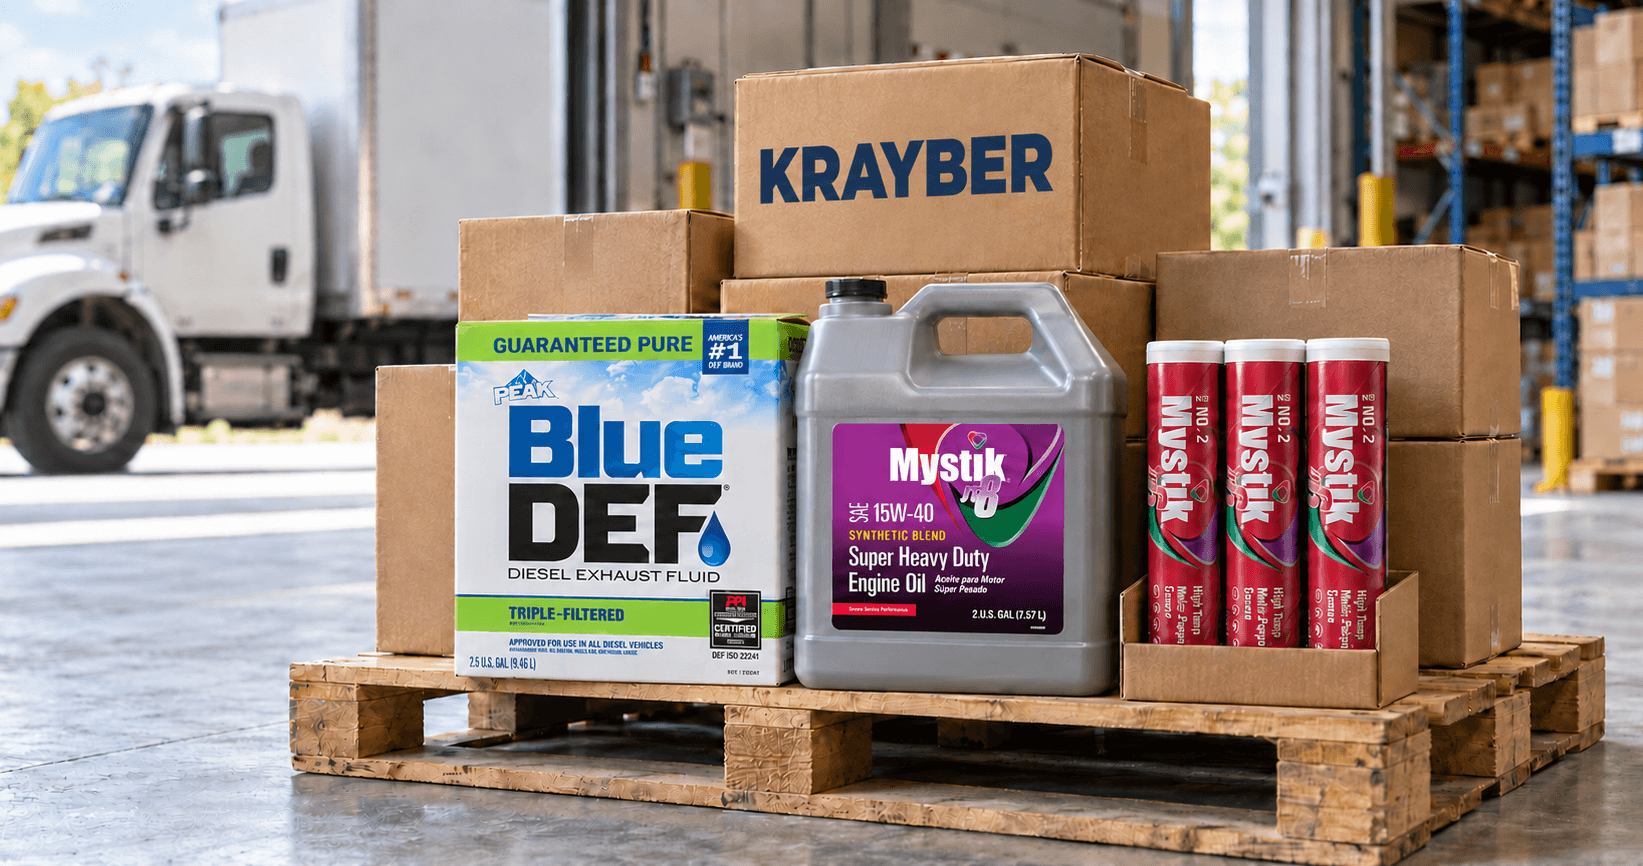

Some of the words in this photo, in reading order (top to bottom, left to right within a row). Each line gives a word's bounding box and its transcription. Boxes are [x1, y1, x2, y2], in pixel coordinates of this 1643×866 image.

[760, 133, 1053, 204] KRAYBER
[493, 336, 631, 354] GUARANTEED
[638, 336, 693, 352] PURE
[708, 334, 743, 342] AMERICA'S
[708, 342, 742, 359] #1
[493, 379, 556, 406] PEAK
[508, 405, 723, 479] Blue
[889, 447, 1006, 485] Mystik
[1158, 396, 1193, 523] Mystik
[1239, 394, 1274, 523] Mystik
[1322, 394, 1360, 524] Mystik
[849, 503, 869, 523] SAE
[874, 503, 934, 522] 15W-40
[508, 483, 722, 564] DEF
[849, 530, 908, 541] SYNTHETIC
[912, 530, 946, 541] BLEND
[849, 546, 894, 570] Super
[899, 546, 948, 570] Heavy
[953, 547, 989, 572] Duty
[508, 568, 574, 581] DIESEL
[576, 569, 662, 582] EXHAUST
[666, 571, 720, 583] FLUID
[849, 573, 900, 596] Engine
[906, 574, 926, 593] Oil
[981, 575, 1005, 583] Motor
[959, 585, 987, 593] Pesado
[509, 606, 624, 622] TRIPLE-FILTERED
[998, 610, 1014, 620] GAL
[1016, 610, 1036, 621] (7.57
[1038, 611, 1046, 622] L)
[509, 639, 546, 647] APPROVED
[548, 639, 562, 647] FOR
[579, 640, 587, 648] IN
[588, 640, 601, 648] ALL
[603, 641, 627, 649] DIESEL
[629, 641, 664, 649] VEHICLES
[469, 656, 480, 668] 2.5
[495, 657, 509, 669] GAL
[511, 657, 528, 670] (9.46
[530, 658, 536, 670] L)
[712, 651, 725, 659] DEF
